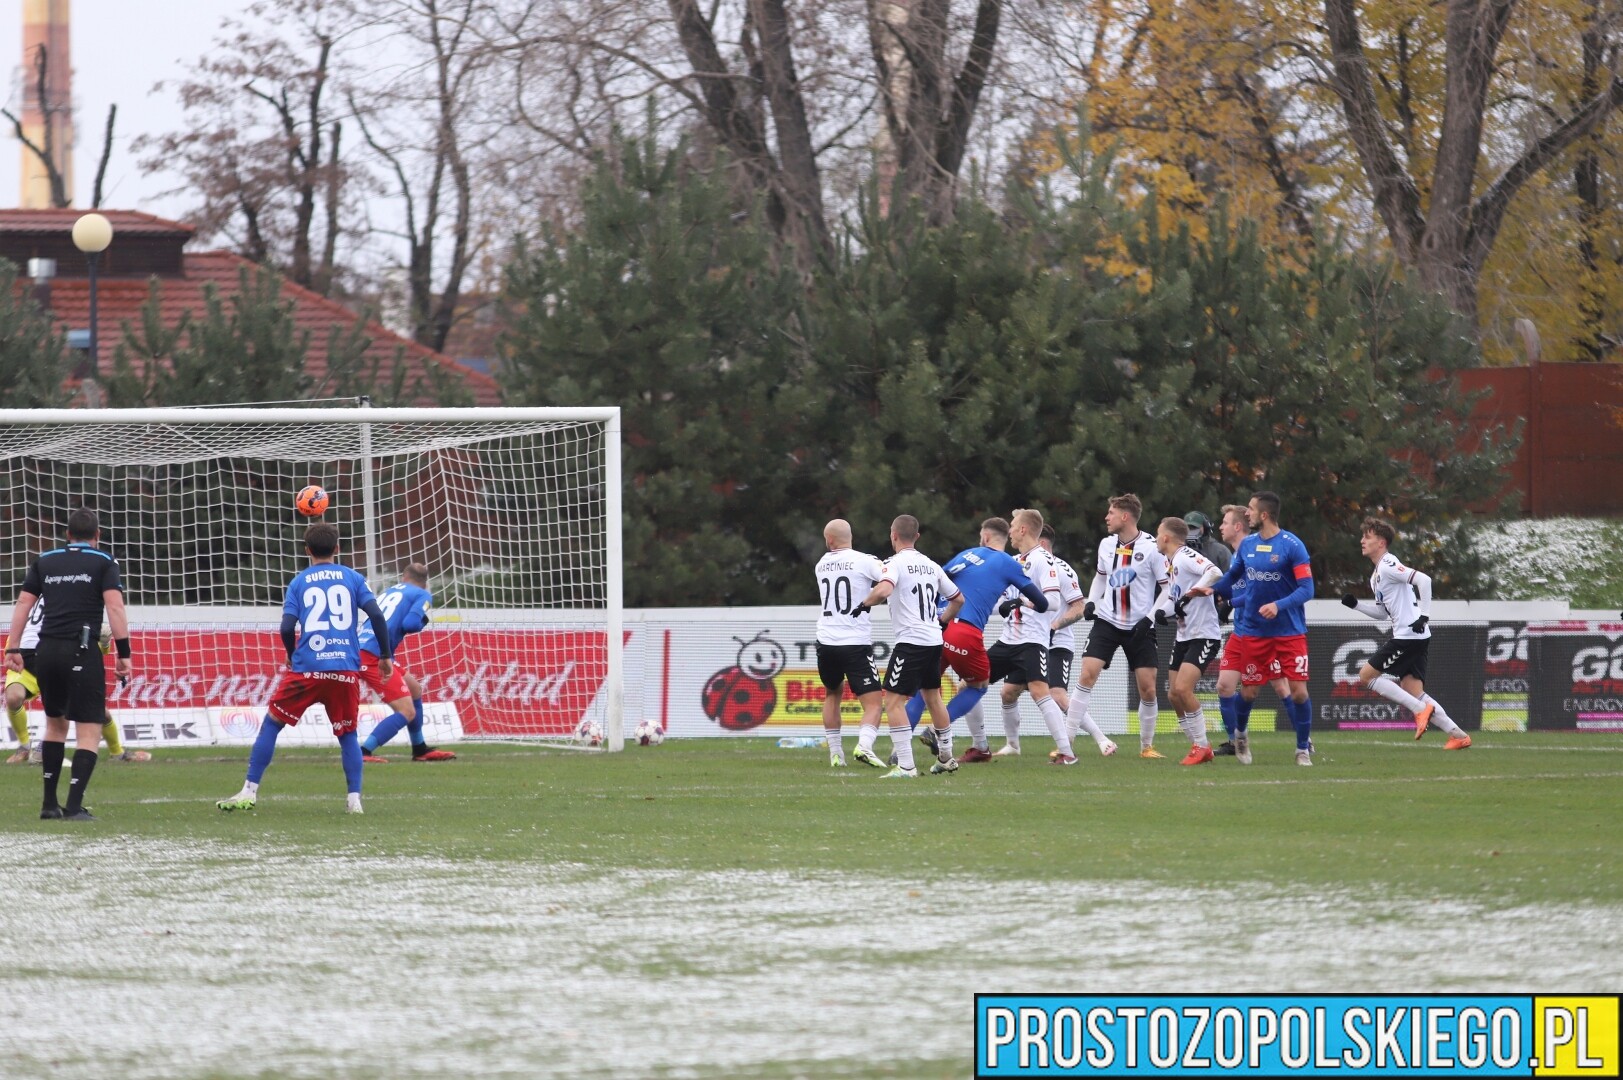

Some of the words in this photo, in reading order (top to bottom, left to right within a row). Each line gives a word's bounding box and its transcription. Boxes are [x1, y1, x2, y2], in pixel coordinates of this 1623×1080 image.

[305, 569, 343, 584] SURZYN
[821, 576, 851, 616] 20
[911, 582, 936, 622] 10
[303, 584, 353, 633] 29
[326, 638, 350, 646] OPOLE
[943, 641, 969, 656] DBAD
[1295, 655, 1309, 673] 27
[312, 671, 356, 684] SINDBAD
[422, 713, 453, 726] OLE
[1320, 703, 1400, 721] ENERGY
